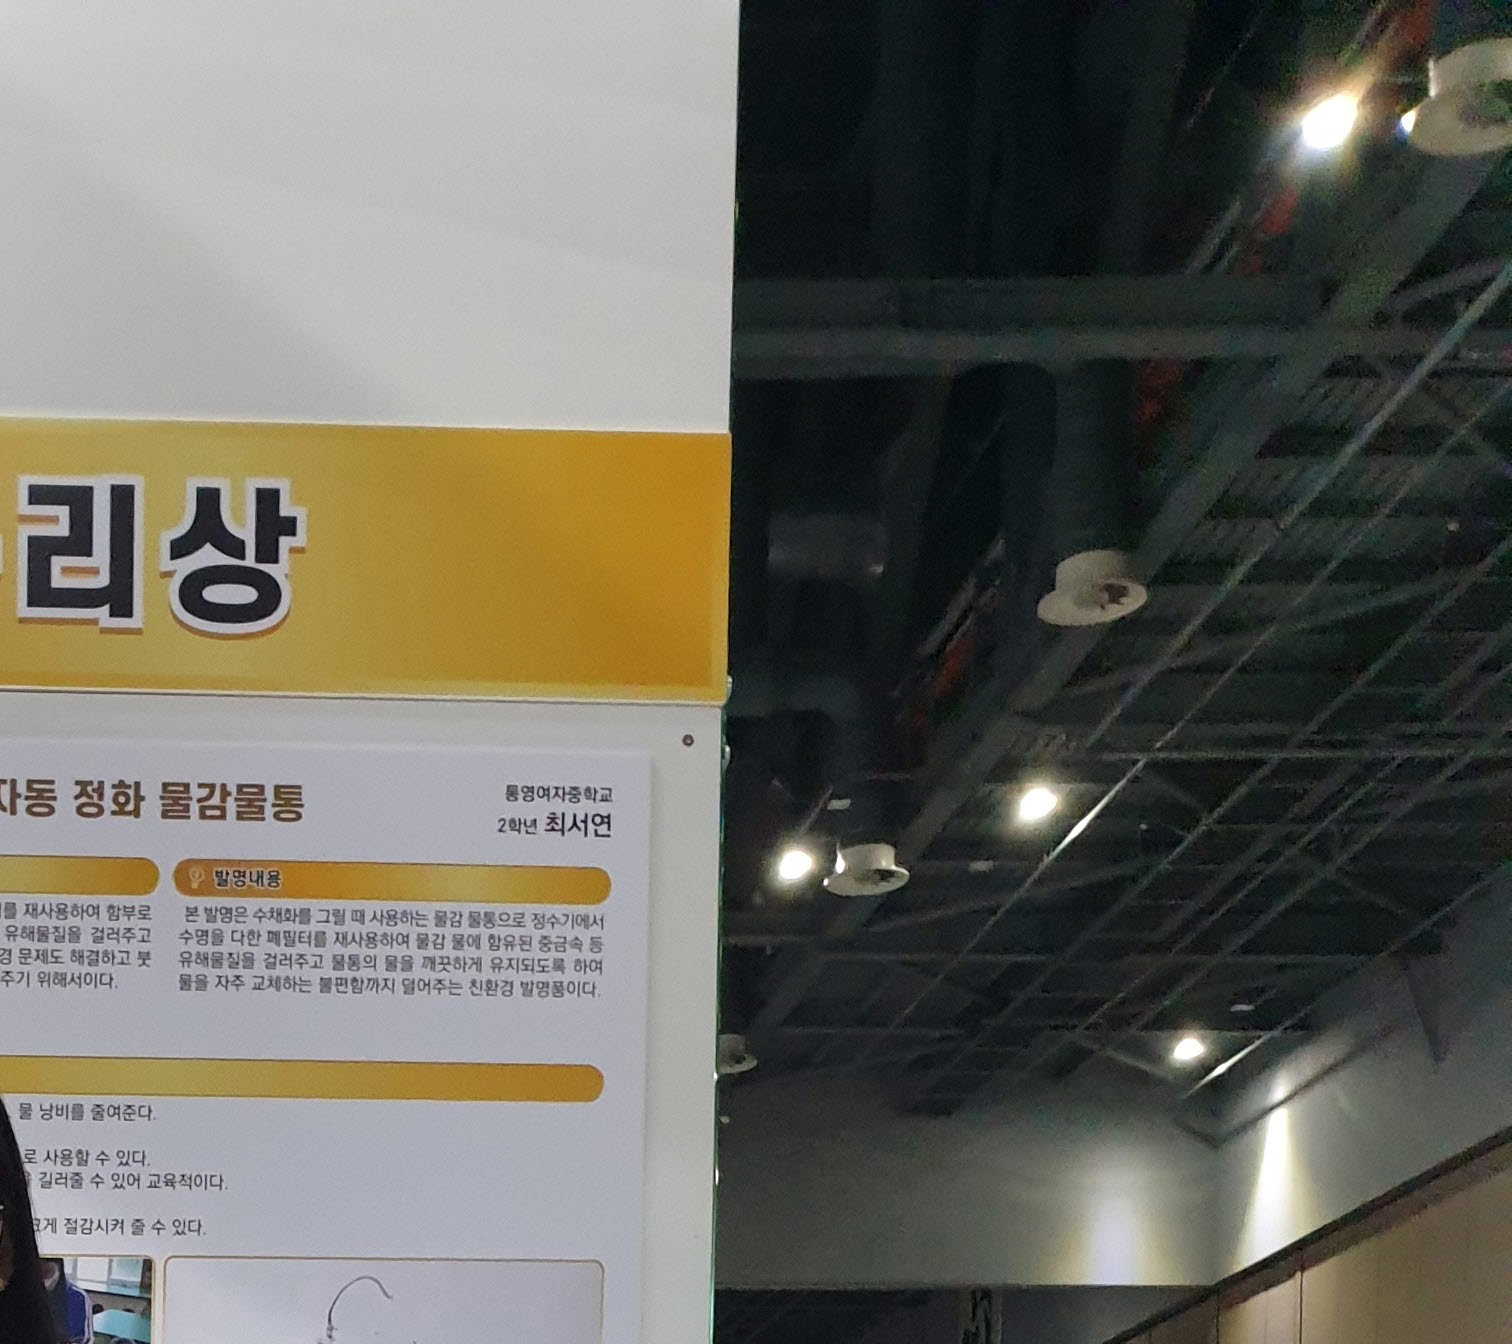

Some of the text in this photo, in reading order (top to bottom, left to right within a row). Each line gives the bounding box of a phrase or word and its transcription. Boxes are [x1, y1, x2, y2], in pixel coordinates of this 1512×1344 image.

[73, 778, 145, 819] 정화
[159, 781, 304, 822] 물감물통
[505, 784, 612, 804] 통영여자중학교
[496, 811, 613, 839] 2학년 최서연
[214, 869, 282, 888] 발명내용
[23, 902, 100, 921] 재사용하여
[107, 904, 152, 922] 함부로
[5, 924, 81, 944] 유해물질을
[90, 927, 151, 944] 걸러주고
[18, 1103, 32, 1120] 물
[39, 1103, 84, 1121] 낭비를
[90, 1104, 155, 1122] 줄여준다.
[39, 1171, 83, 1189] 길러줄
[89, 1173, 104, 1189] 수
[111, 1172, 140, 1190] 있어
[146, 1172, 227, 1191] 교육적이다.
